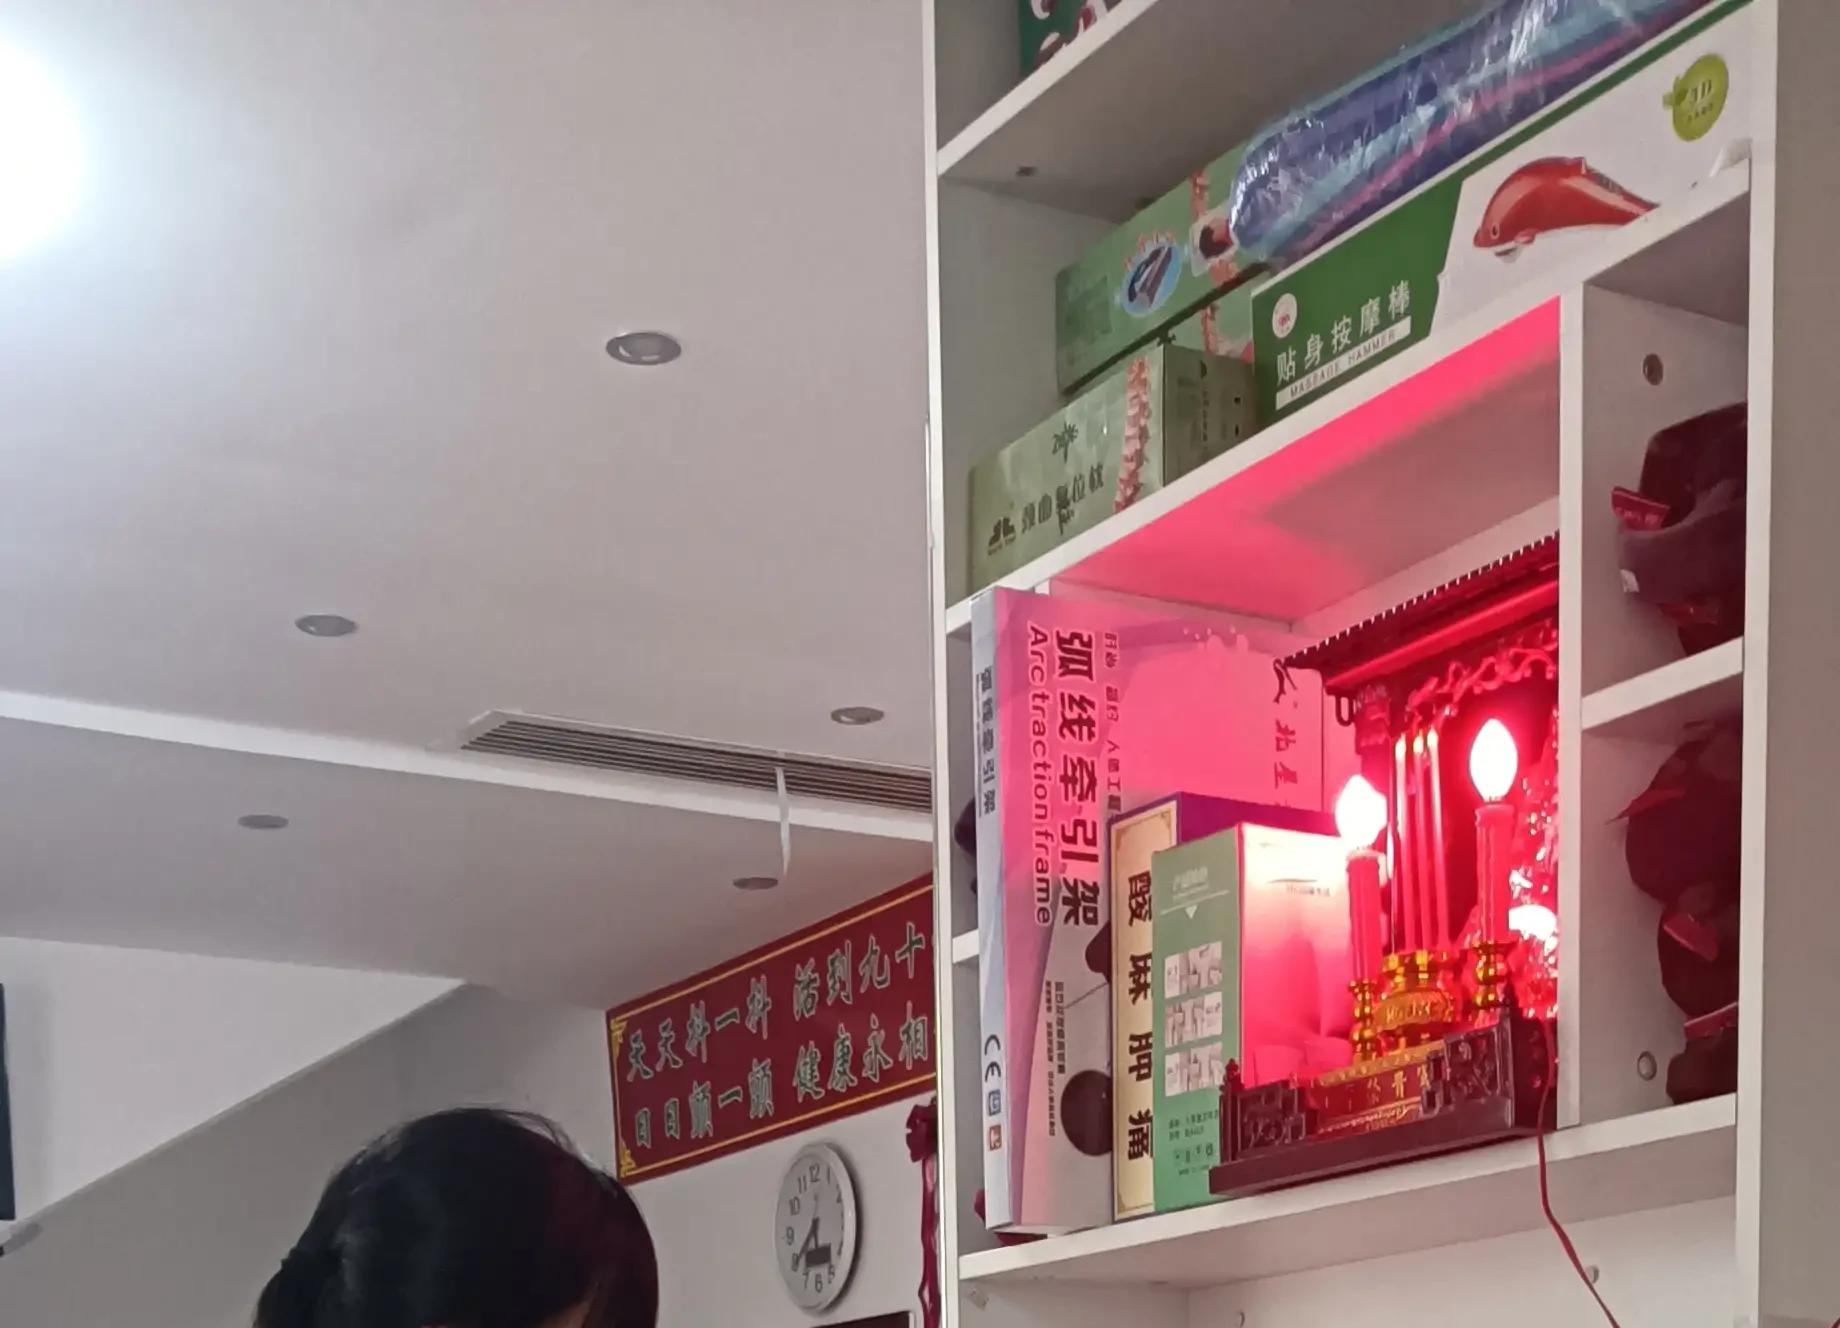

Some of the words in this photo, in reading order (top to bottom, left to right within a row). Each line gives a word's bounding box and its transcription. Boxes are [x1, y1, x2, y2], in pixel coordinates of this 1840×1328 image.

[1277, 279, 1410, 386] 贴身按摩棒
[1028, 625, 1048, 684] Arc
[1030, 689, 1051, 823] traction
[1055, 627, 1101, 928] 弧线牵引架
[1033, 829, 1055, 926] frame
[793, 921, 934, 1021] 活到九十
[793, 1000, 935, 1103] 健康永相
[789, 1196, 801, 1216] 10
[808, 1162, 820, 1183] 12
[786, 1226, 795, 1246] 9
[815, 1273, 823, 1294] 6
